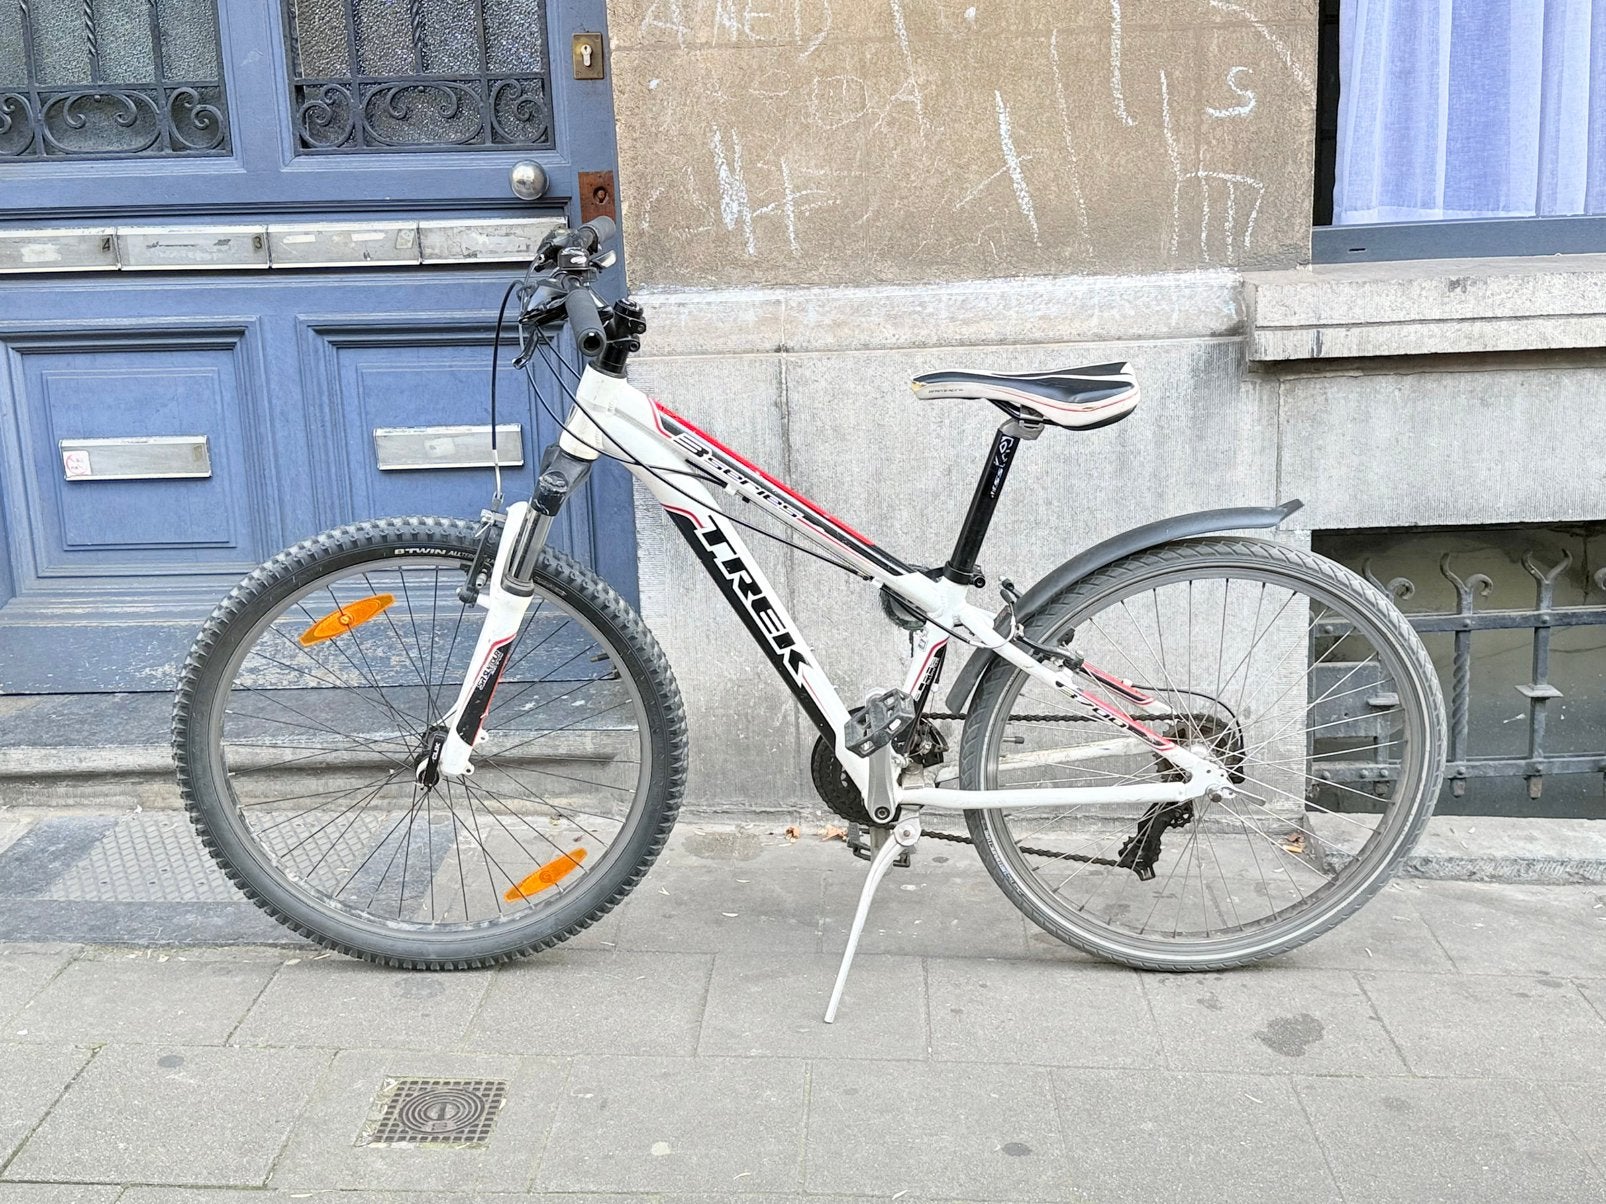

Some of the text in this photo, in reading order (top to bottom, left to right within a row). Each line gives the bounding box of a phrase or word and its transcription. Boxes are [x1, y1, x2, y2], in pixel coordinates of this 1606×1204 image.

[102, 237, 111, 251] 4
[253, 235, 263, 249] 3
[701, 514, 814, 677] TREK
[1055, 680, 1129, 730] 3700
